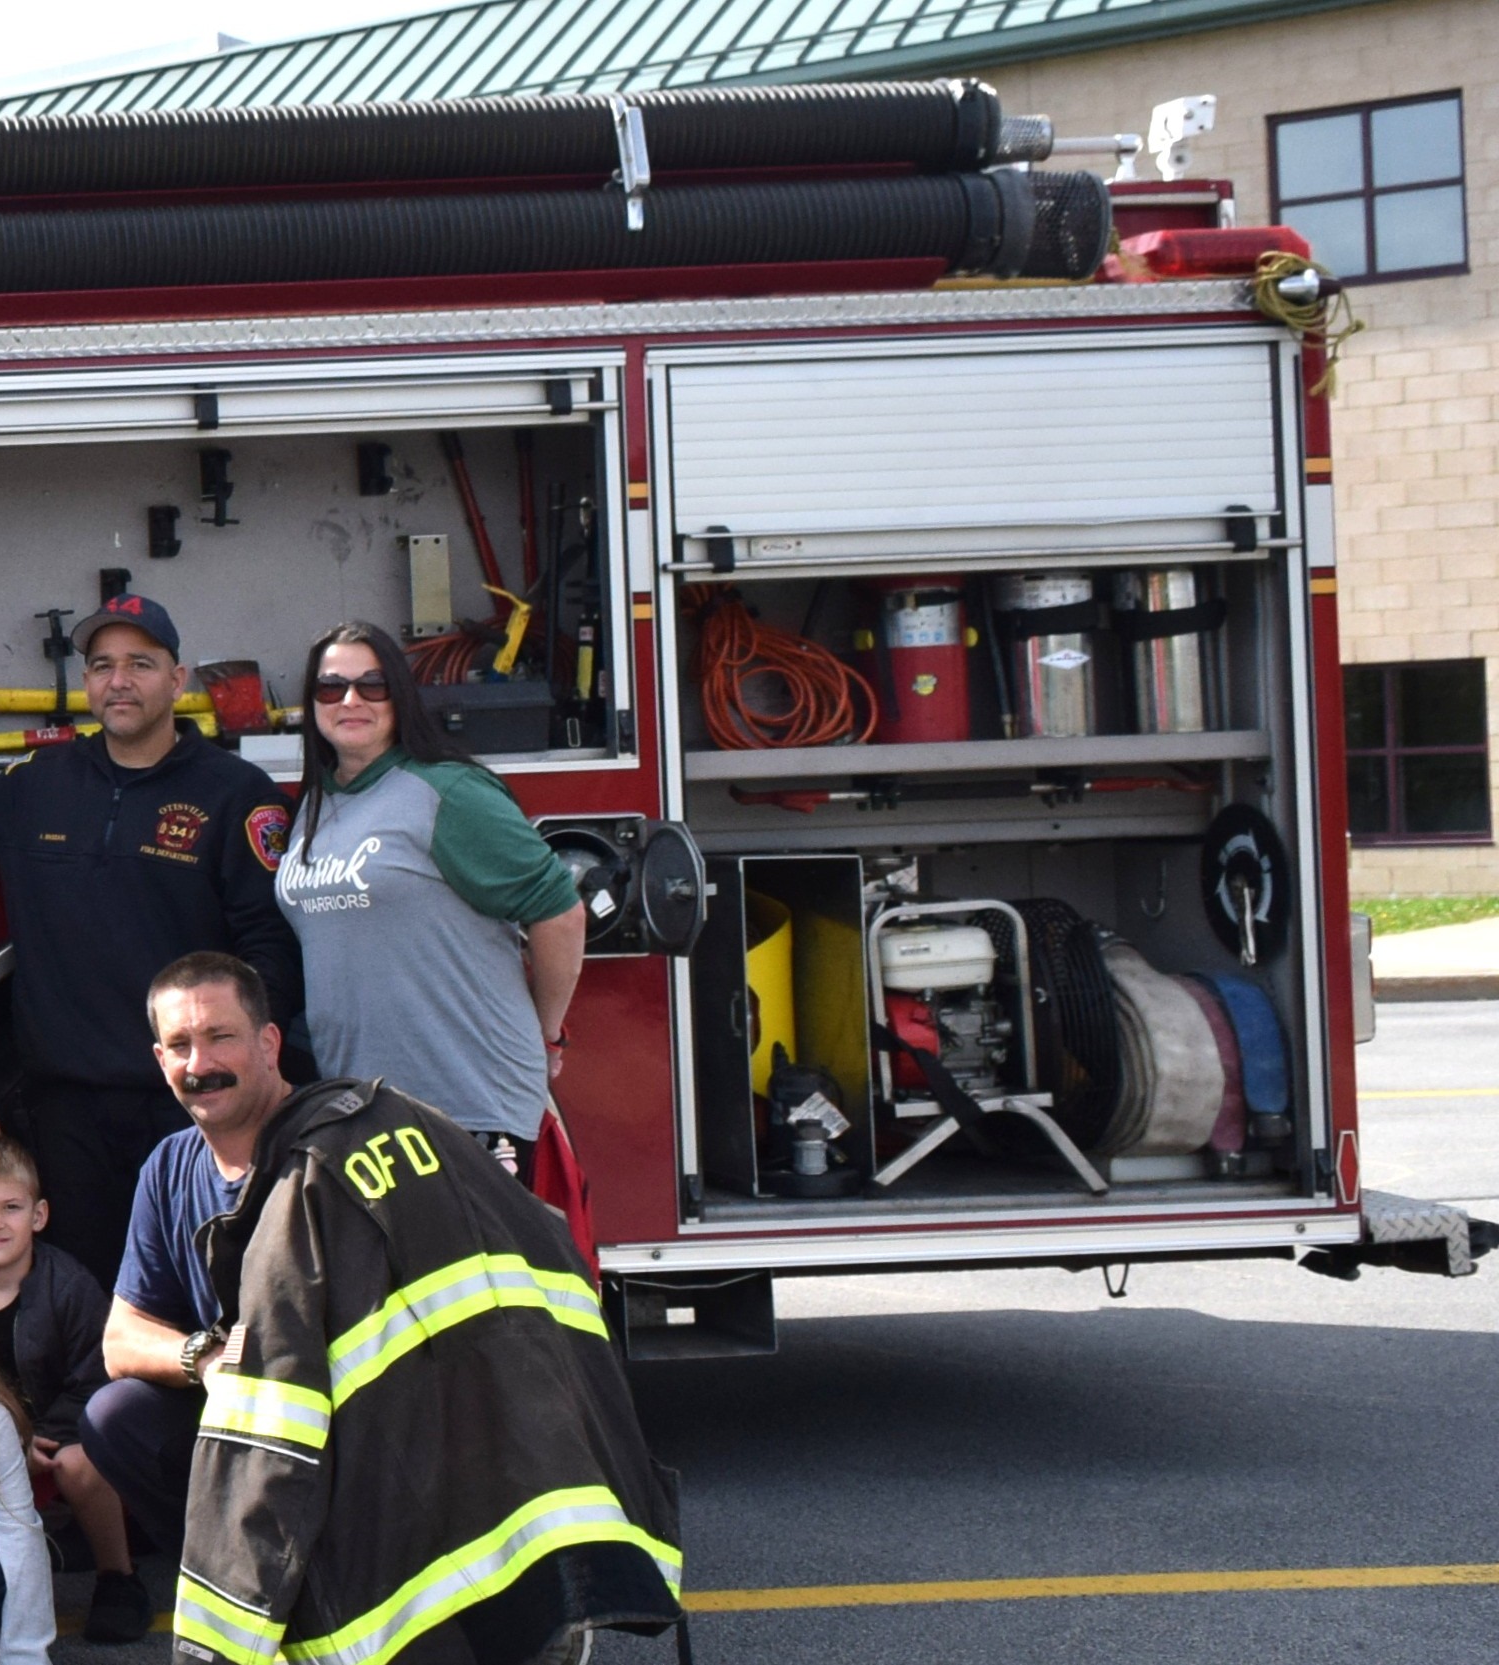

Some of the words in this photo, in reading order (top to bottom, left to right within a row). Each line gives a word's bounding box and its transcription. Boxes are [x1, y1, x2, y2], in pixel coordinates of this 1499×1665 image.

[158, 803, 209, 823] OTISVILLE
[168, 825, 187, 838] 34
[300, 893, 371, 914] WARRIORS
[344, 1127, 440, 1199] OFD
